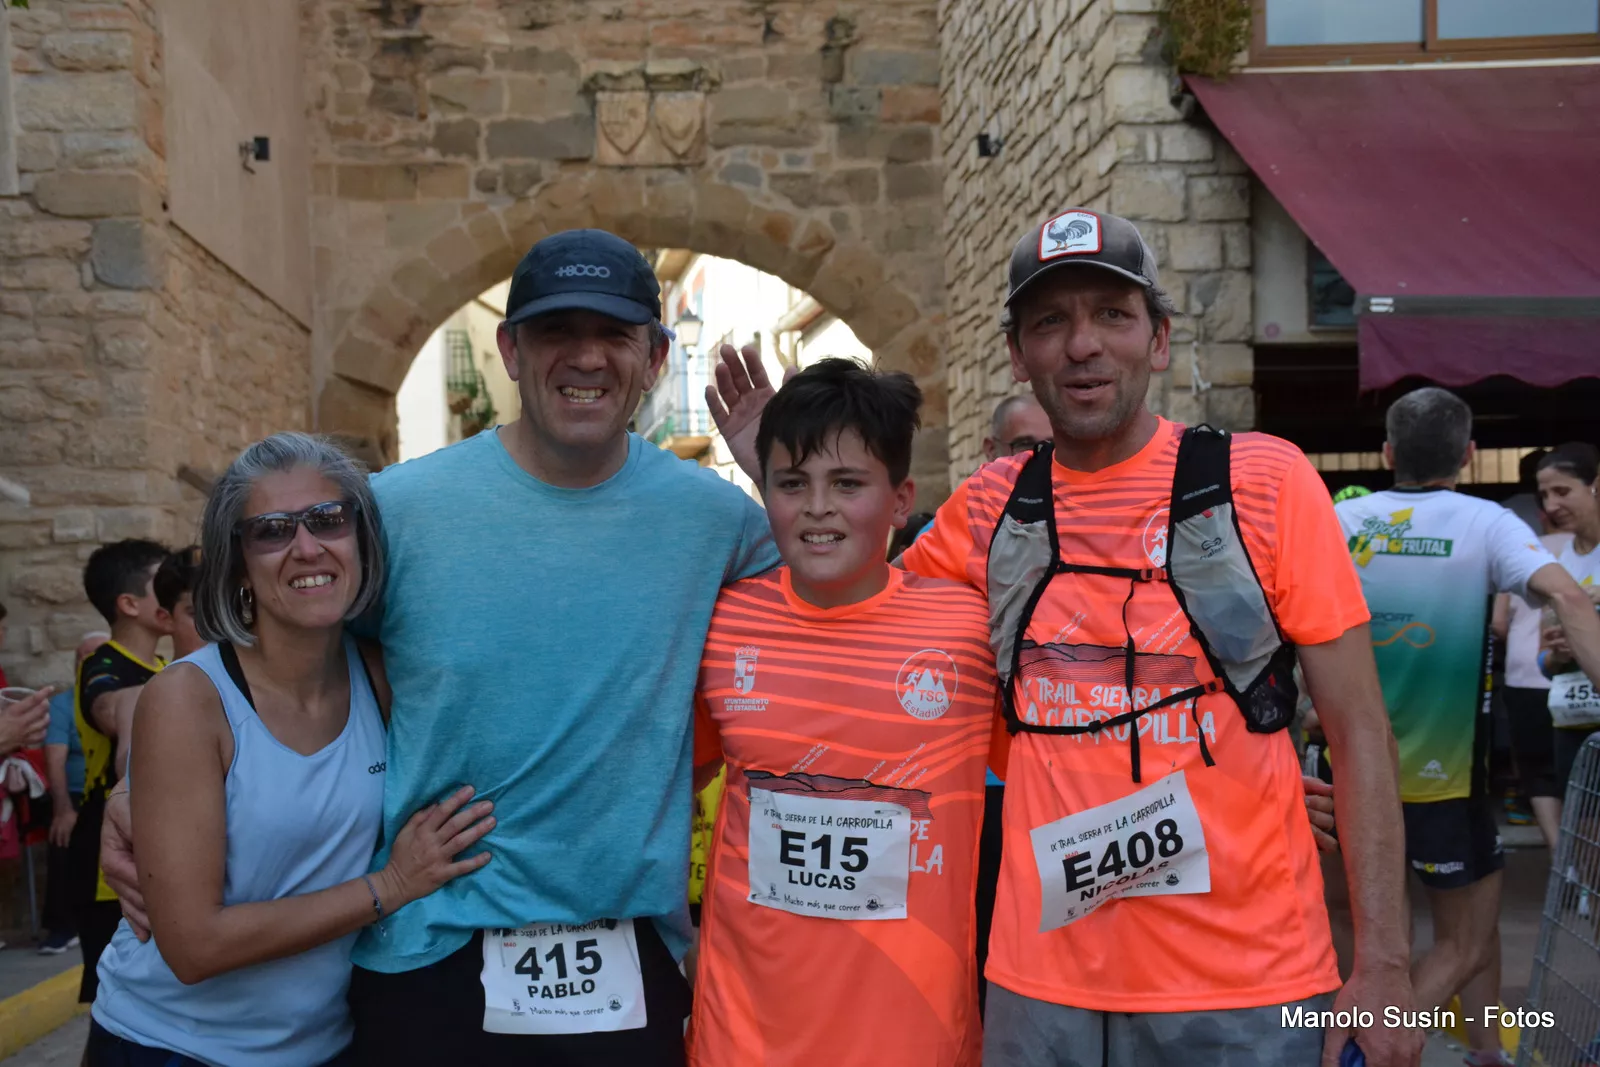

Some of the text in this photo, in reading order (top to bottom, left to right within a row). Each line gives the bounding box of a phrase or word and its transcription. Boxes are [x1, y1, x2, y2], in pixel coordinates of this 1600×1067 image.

[917, 689, 945, 703] TSC
[1036, 677, 1081, 705] TRAIL
[1089, 685, 1161, 711] SIERRA
[1564, 684, 1600, 701] 45
[903, 699, 947, 718] Estadilla
[1046, 706, 1217, 744] CARRODILLA
[784, 813, 807, 825] SIERRA
[808, 816, 818, 825] DE
[820, 815, 833, 827] LA
[836, 817, 893, 830] CARRODILLA
[1058, 837, 1077, 850] TRAIL
[1078, 827, 1102, 843] SIERRA
[1103, 823, 1113, 834] DE
[1115, 816, 1129, 830] LA
[1130, 793, 1176, 825] CARRODILLA
[780, 830, 869, 873] E15
[1062, 818, 1184, 893] E408
[788, 870, 856, 890] LUCAS
[1080, 861, 1170, 902] NICOLAS
[784, 893, 804, 907] Mucho
[807, 900, 821, 909] más
[824, 903, 836, 912] que
[838, 904, 861, 912] correr
[550, 924, 563, 936] LA
[514, 938, 602, 981] 415
[527, 979, 596, 999] PABLO
[583, 1008, 604, 1016] correr
